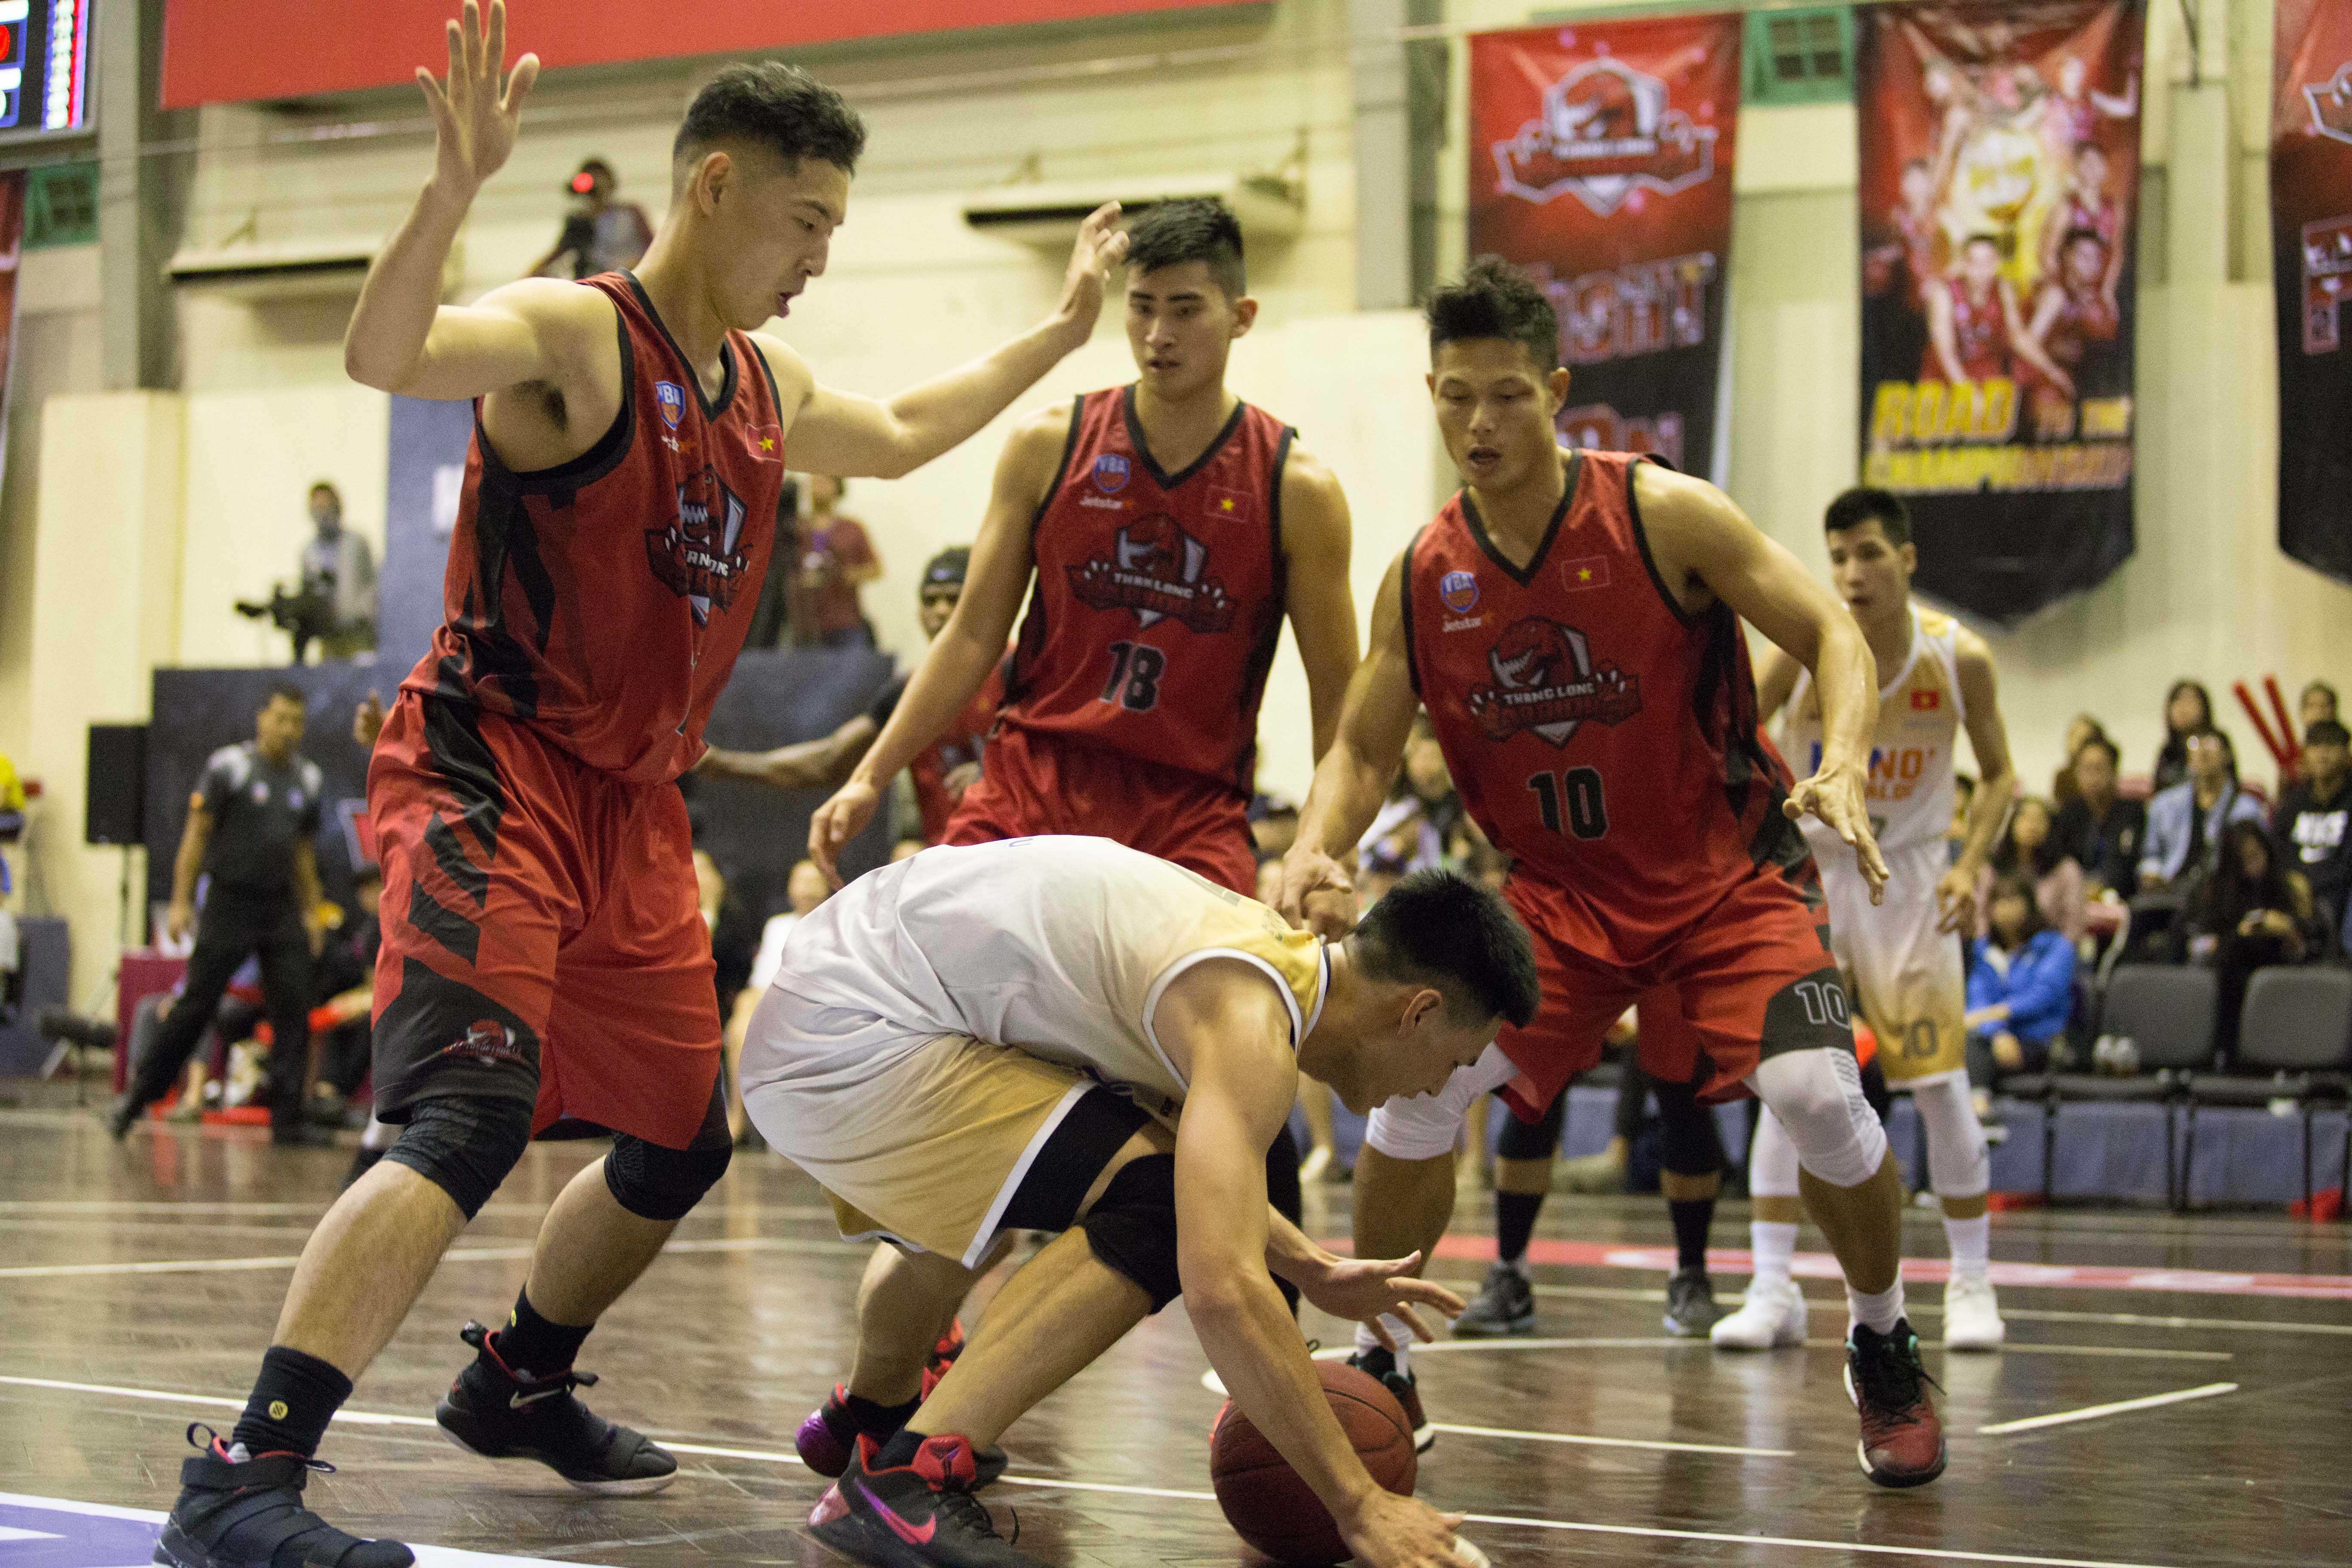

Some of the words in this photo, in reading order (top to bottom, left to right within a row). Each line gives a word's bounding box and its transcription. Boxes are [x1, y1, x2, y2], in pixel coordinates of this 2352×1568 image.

[1871, 376, 2018, 441] ROAD
[1099, 641, 1166, 713] 18
[1504, 685, 1555, 705] THANG
[1556, 682, 1595, 698] LONG
[1527, 766, 1609, 841] 10
[1795, 981, 1852, 1030] 10
